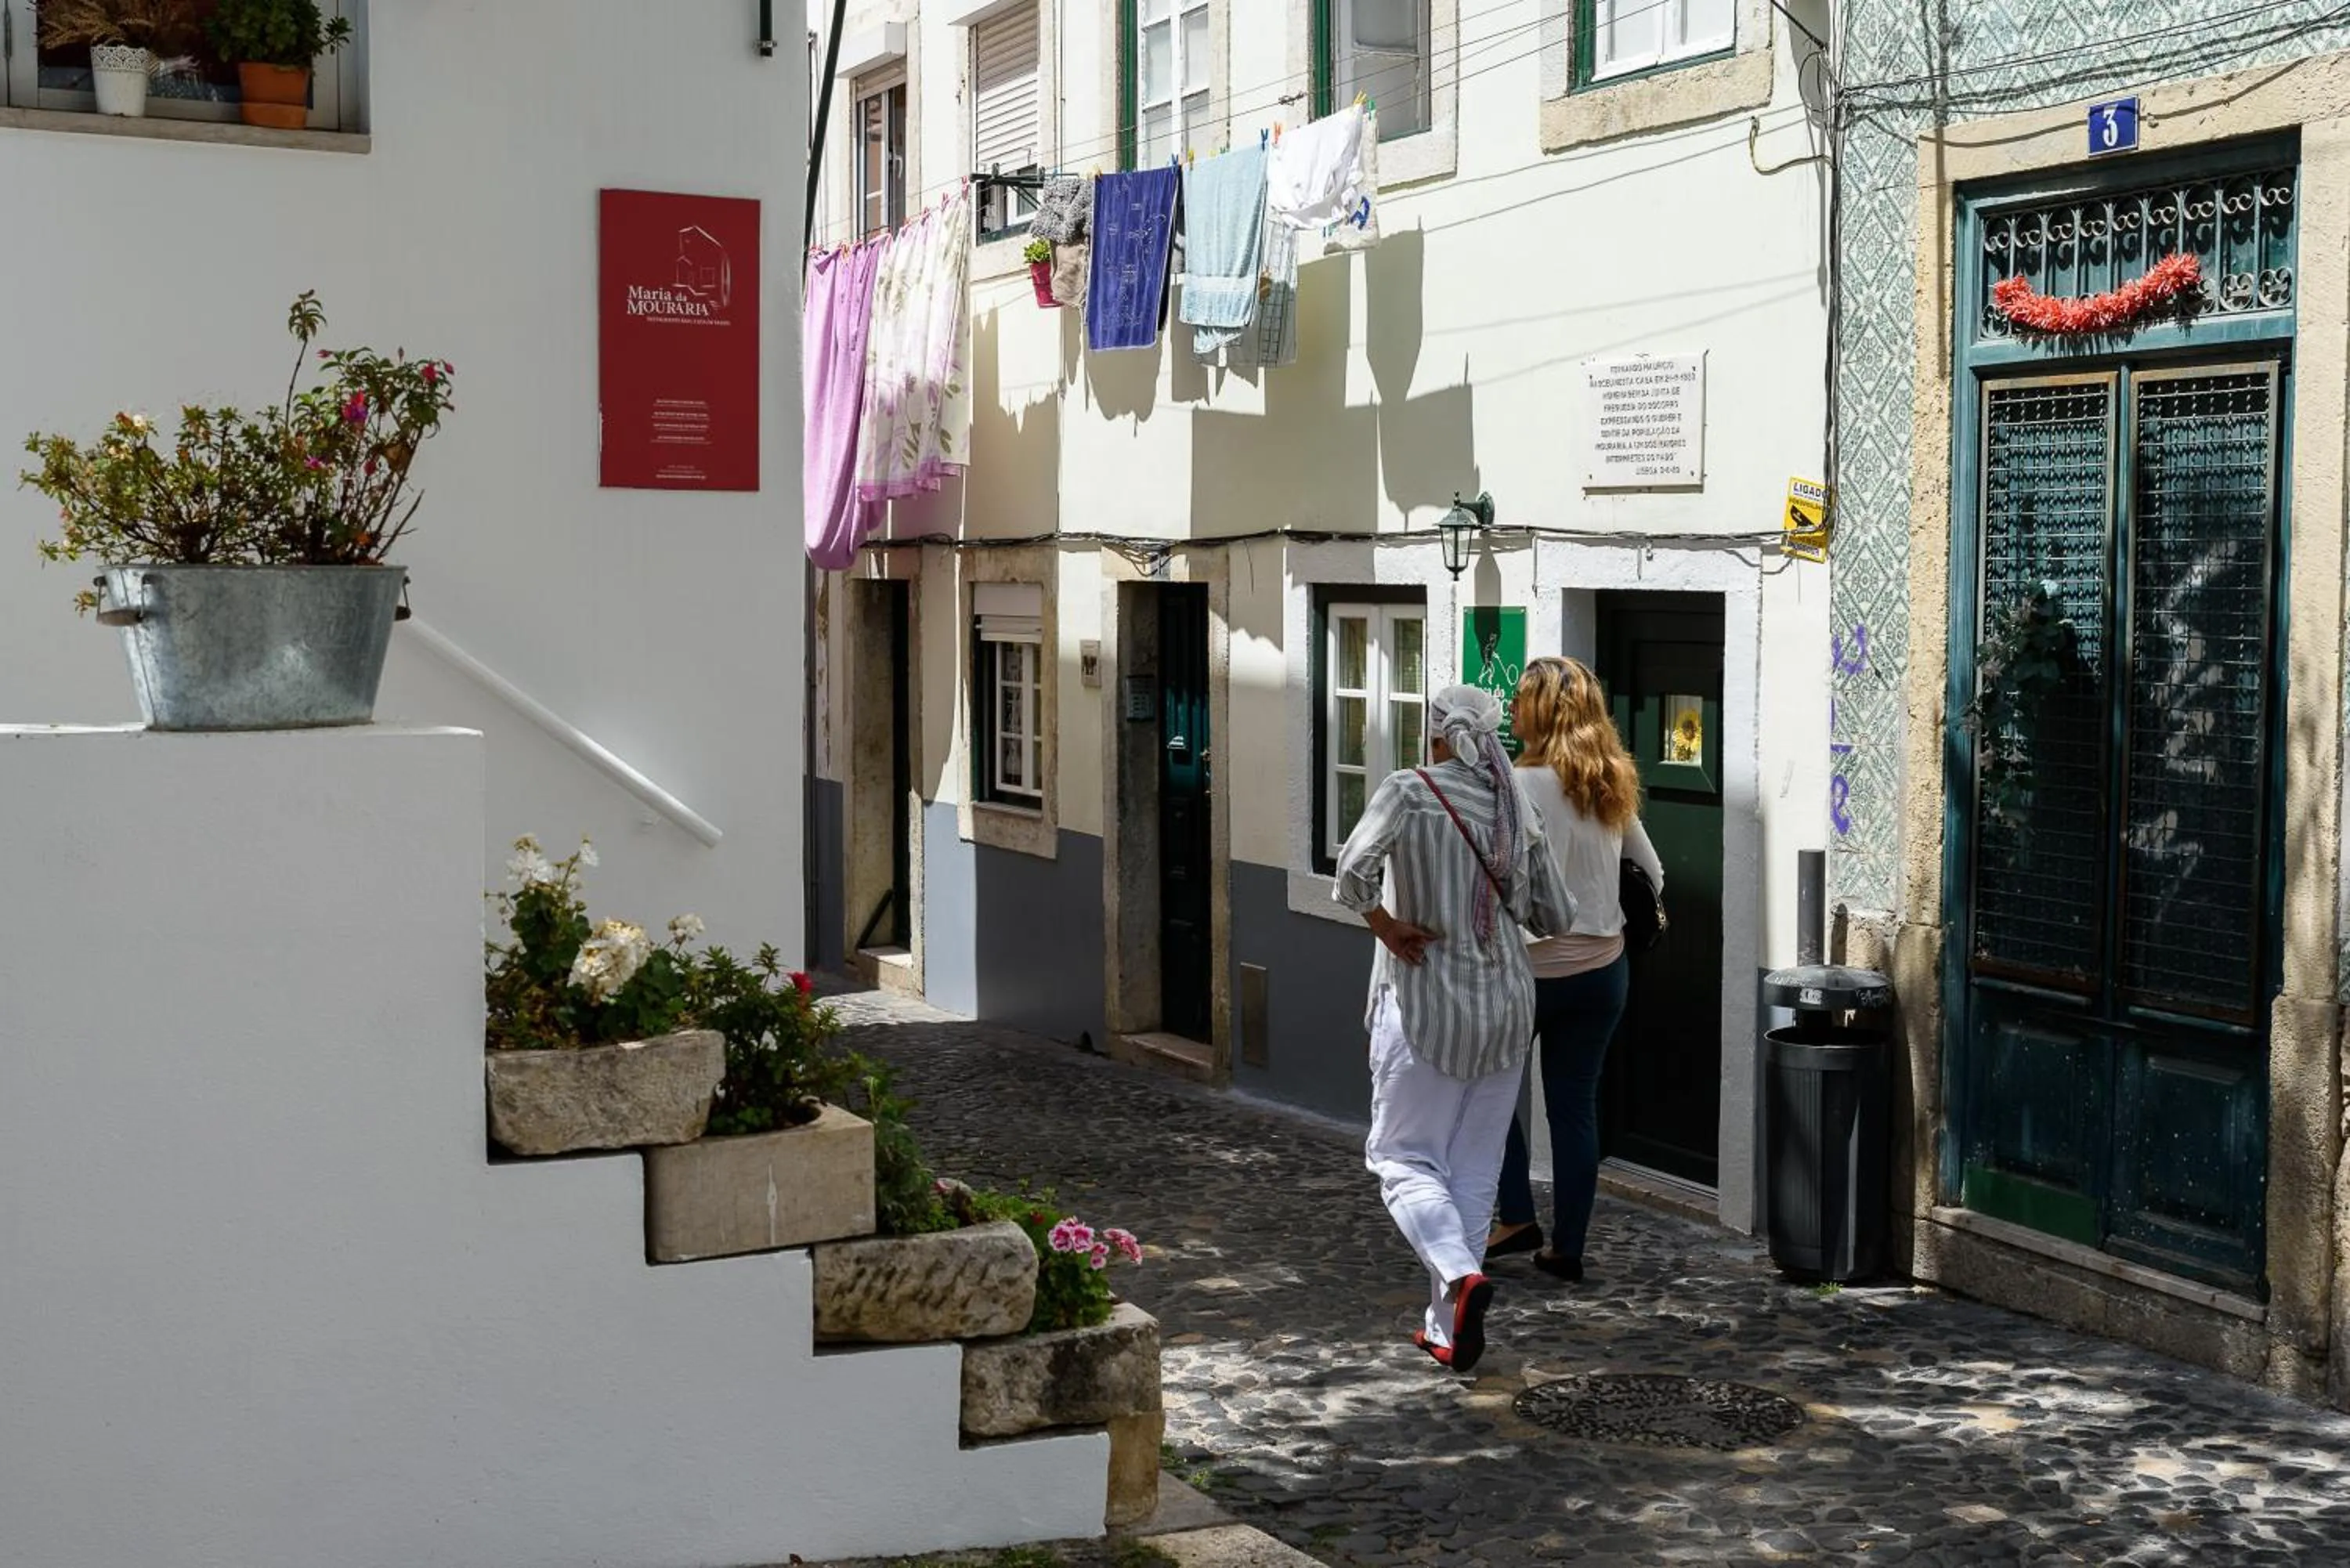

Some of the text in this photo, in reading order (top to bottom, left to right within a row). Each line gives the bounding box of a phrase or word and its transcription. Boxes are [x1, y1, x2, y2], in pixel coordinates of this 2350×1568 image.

[2103, 103, 2118, 146] 3
[628, 285, 687, 302] Maria da
[627, 299, 709, 316] MOURARIA
